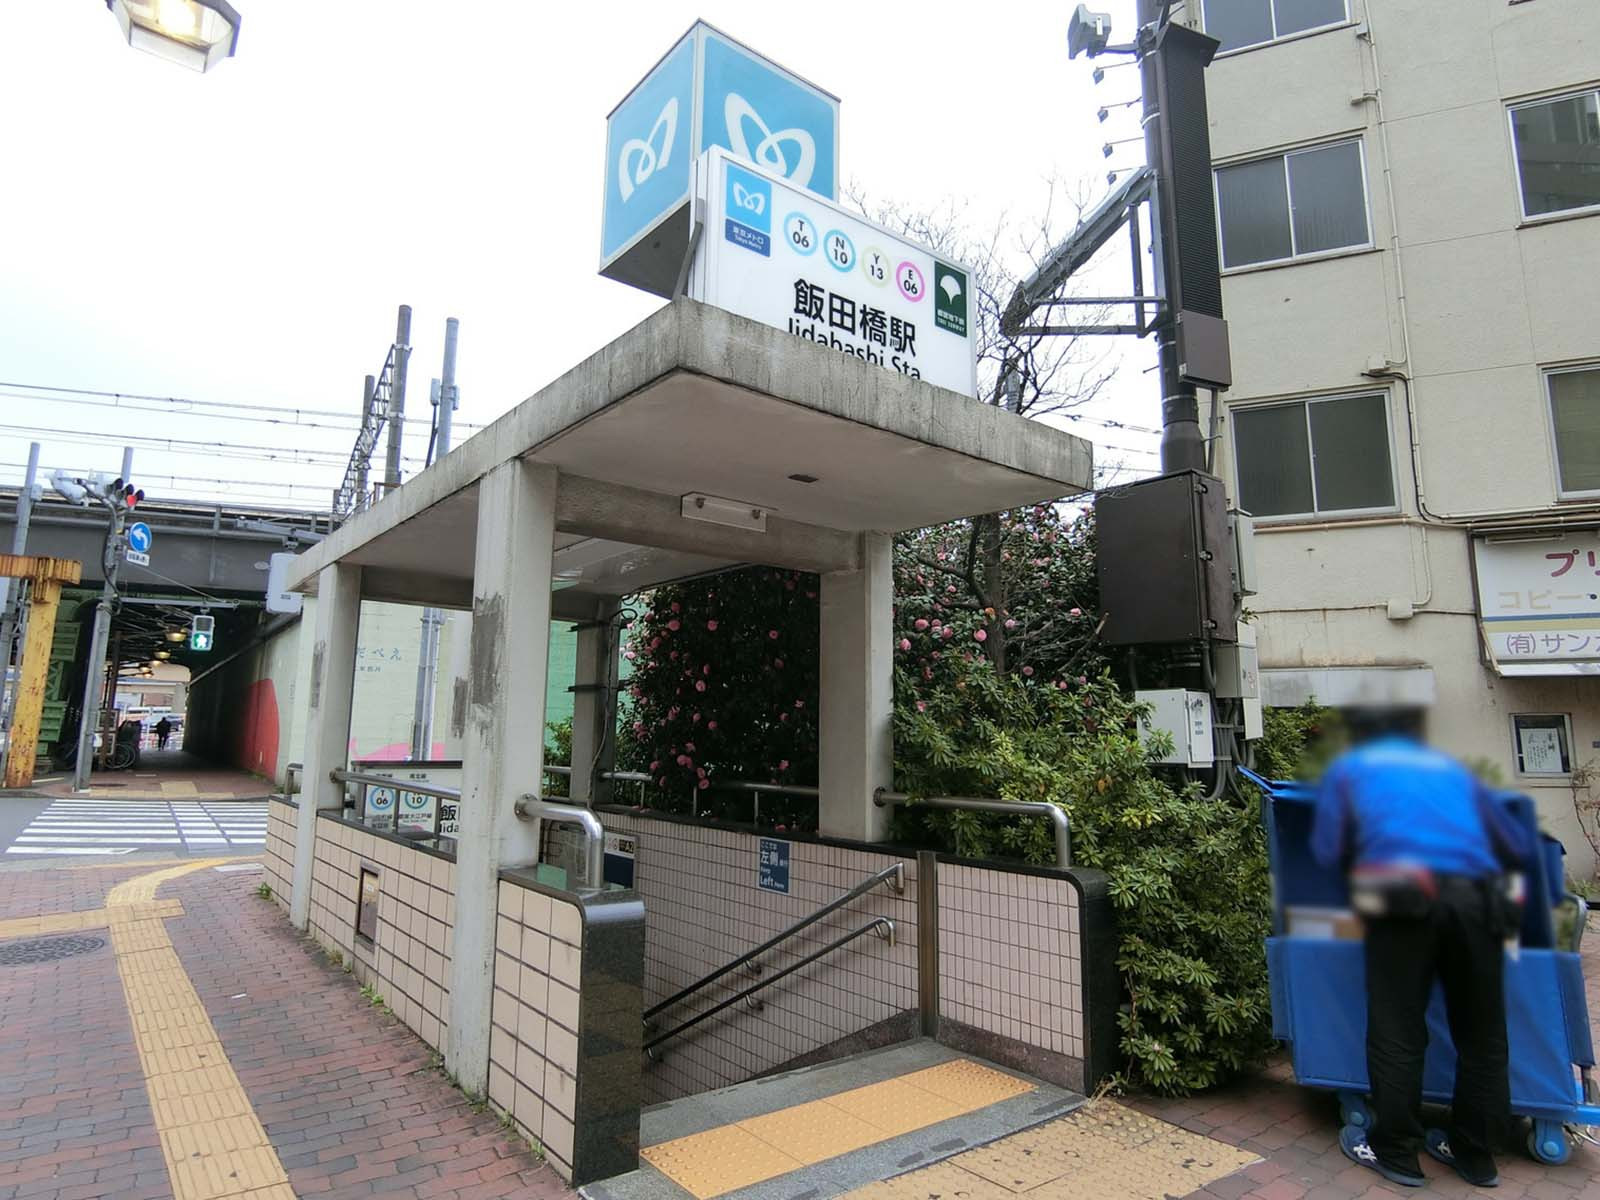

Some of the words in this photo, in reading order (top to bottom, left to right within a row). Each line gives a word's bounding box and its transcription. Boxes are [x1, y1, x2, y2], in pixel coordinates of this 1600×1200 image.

[797, 219, 805, 231] T
[792, 231, 810, 248] 06
[835, 237, 845, 249] N
[833, 249, 848, 265] 10
[873, 253, 880, 265] Y
[870, 264, 884, 280] 13
[908, 269, 913, 280] E
[903, 279, 918, 295] 06
[793, 277, 917, 358] 飯田橋駅
[376, 797, 389, 806] 06
[411, 796, 423, 805] 10
